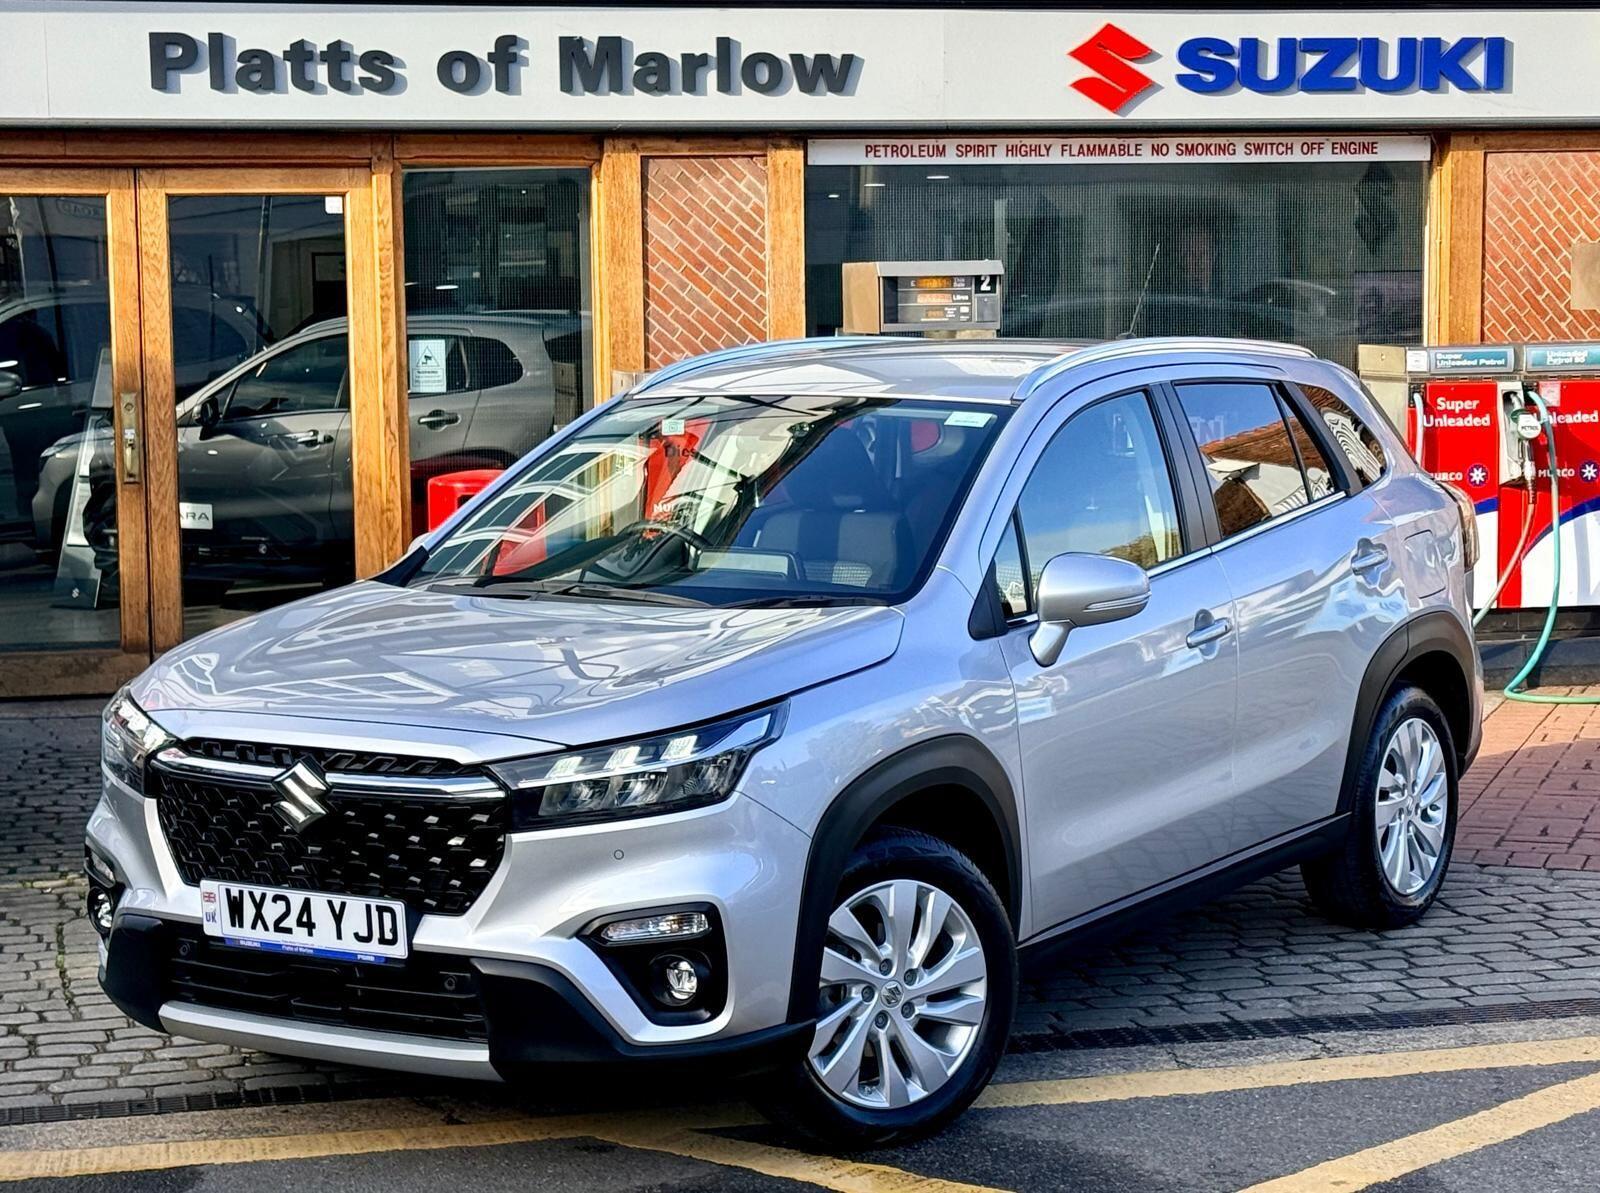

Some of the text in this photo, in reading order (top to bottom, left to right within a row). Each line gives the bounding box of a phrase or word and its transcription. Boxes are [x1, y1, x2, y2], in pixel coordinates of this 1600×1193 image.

[149, 32, 856, 94] Platts of Marlow
[1175, 37, 1506, 94] SUZUKI
[865, 141, 1379, 158] PETROLEUM SPIRIT HIGHLY FLAMMABLE NO SMOKING SWITCH OFF ENGINE
[980, 275, 991, 291] 2
[1436, 397, 1480, 413] Super
[1423, 412, 1491, 427] Unleaded
[205, 911, 217, 924] UK
[225, 887, 399, 946] WX24 YJD
